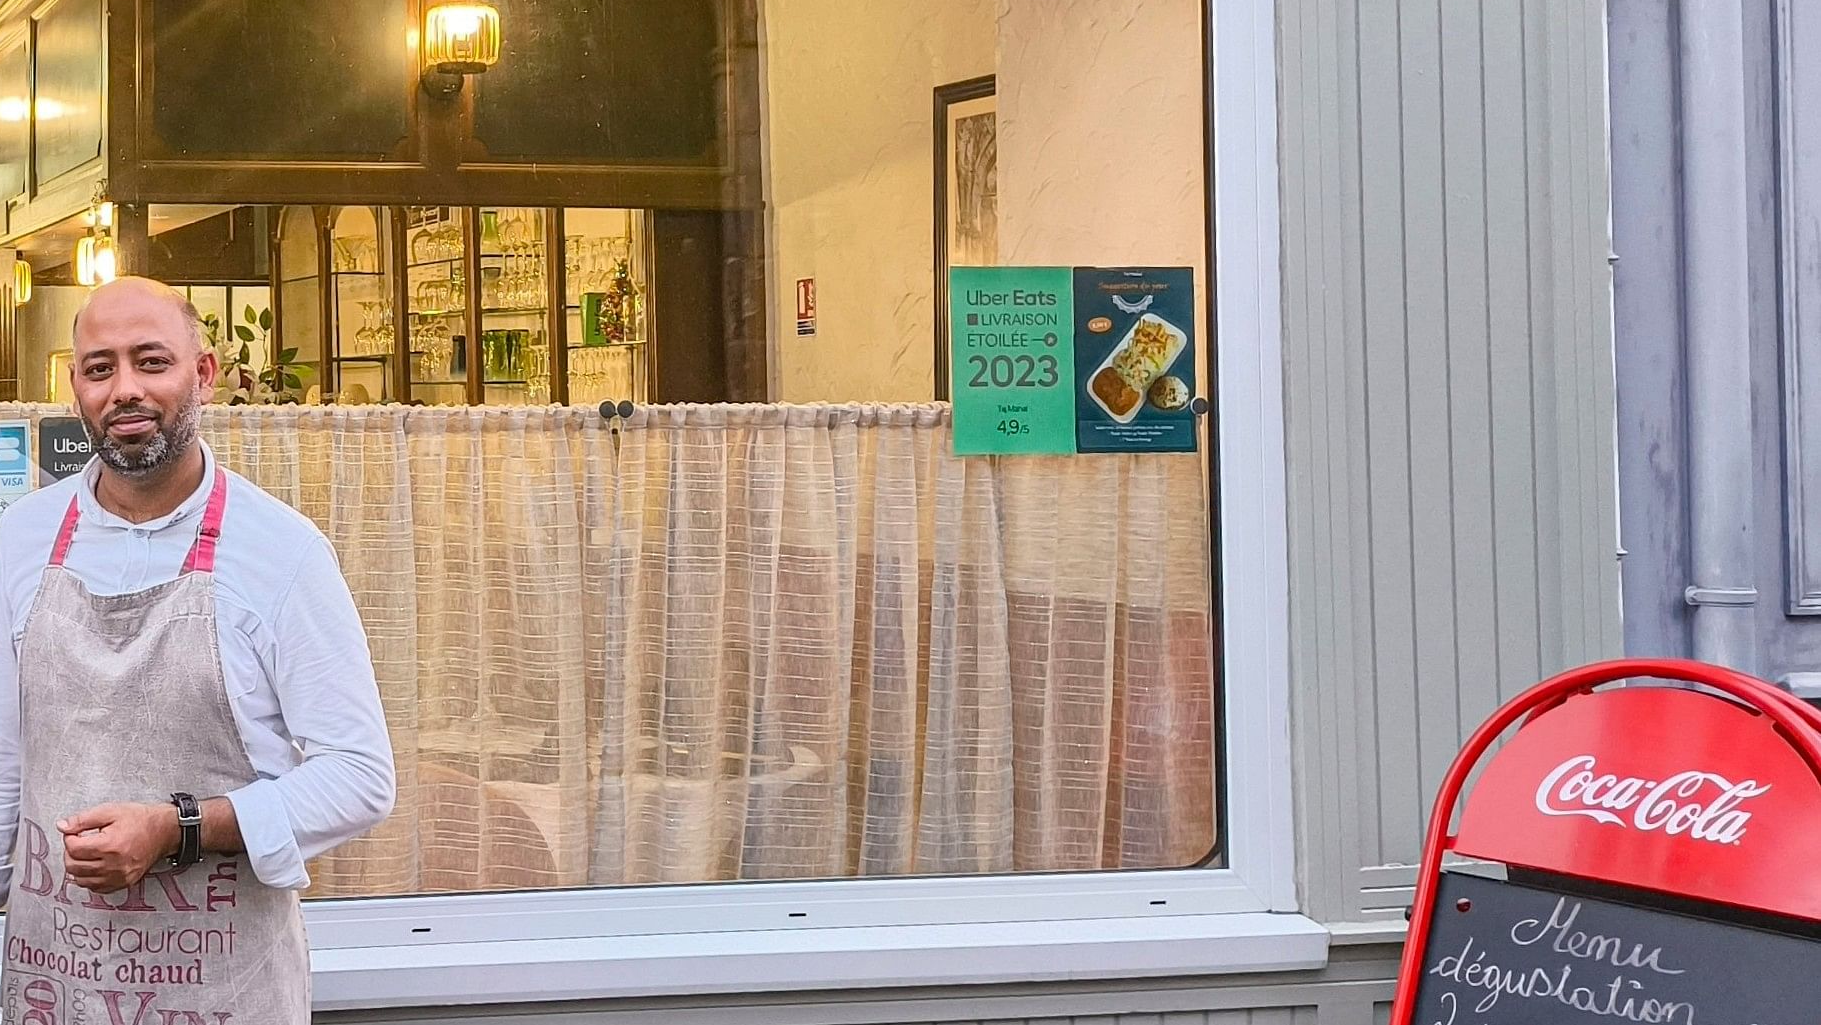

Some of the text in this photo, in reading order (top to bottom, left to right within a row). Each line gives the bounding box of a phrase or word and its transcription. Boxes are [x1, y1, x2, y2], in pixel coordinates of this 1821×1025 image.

[966, 290, 1057, 306] Uber Eats
[981, 313, 1058, 326] LIVRAISON
[968, 354, 1059, 387] 2023
[1, 477, 24, 487] VISA
[1535, 755, 1773, 845] Coca-Cola
[207, 862, 238, 912] Th
[53, 906, 236, 954] Restaurant
[1510, 896, 1686, 974] Menu
[7, 935, 204, 985] Chocolat chaud
[1430, 936, 1695, 1025] dégustation
